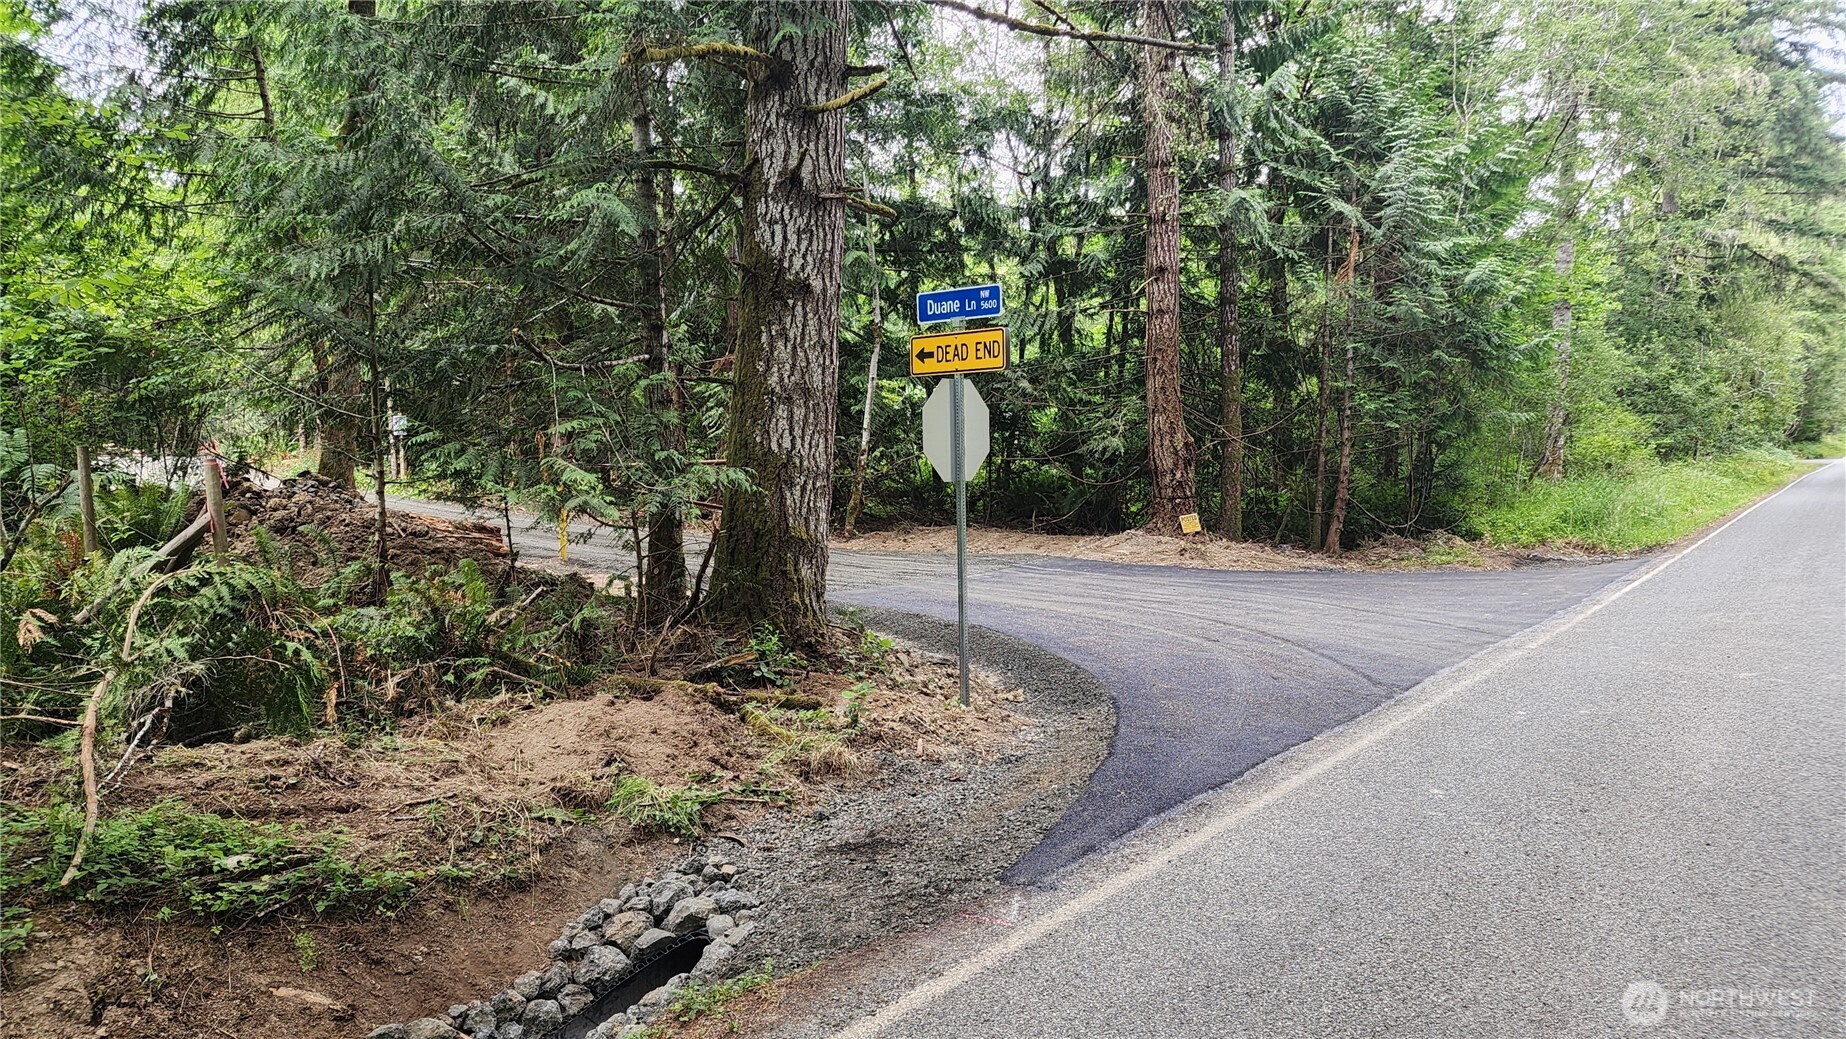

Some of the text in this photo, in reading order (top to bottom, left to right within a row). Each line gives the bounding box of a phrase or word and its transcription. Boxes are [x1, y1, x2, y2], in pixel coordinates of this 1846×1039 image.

[980, 289, 990, 299] NW
[927, 299, 976, 315] Duane Ln
[980, 299, 997, 310] 5600
[936, 340, 1001, 363] DEAD END
